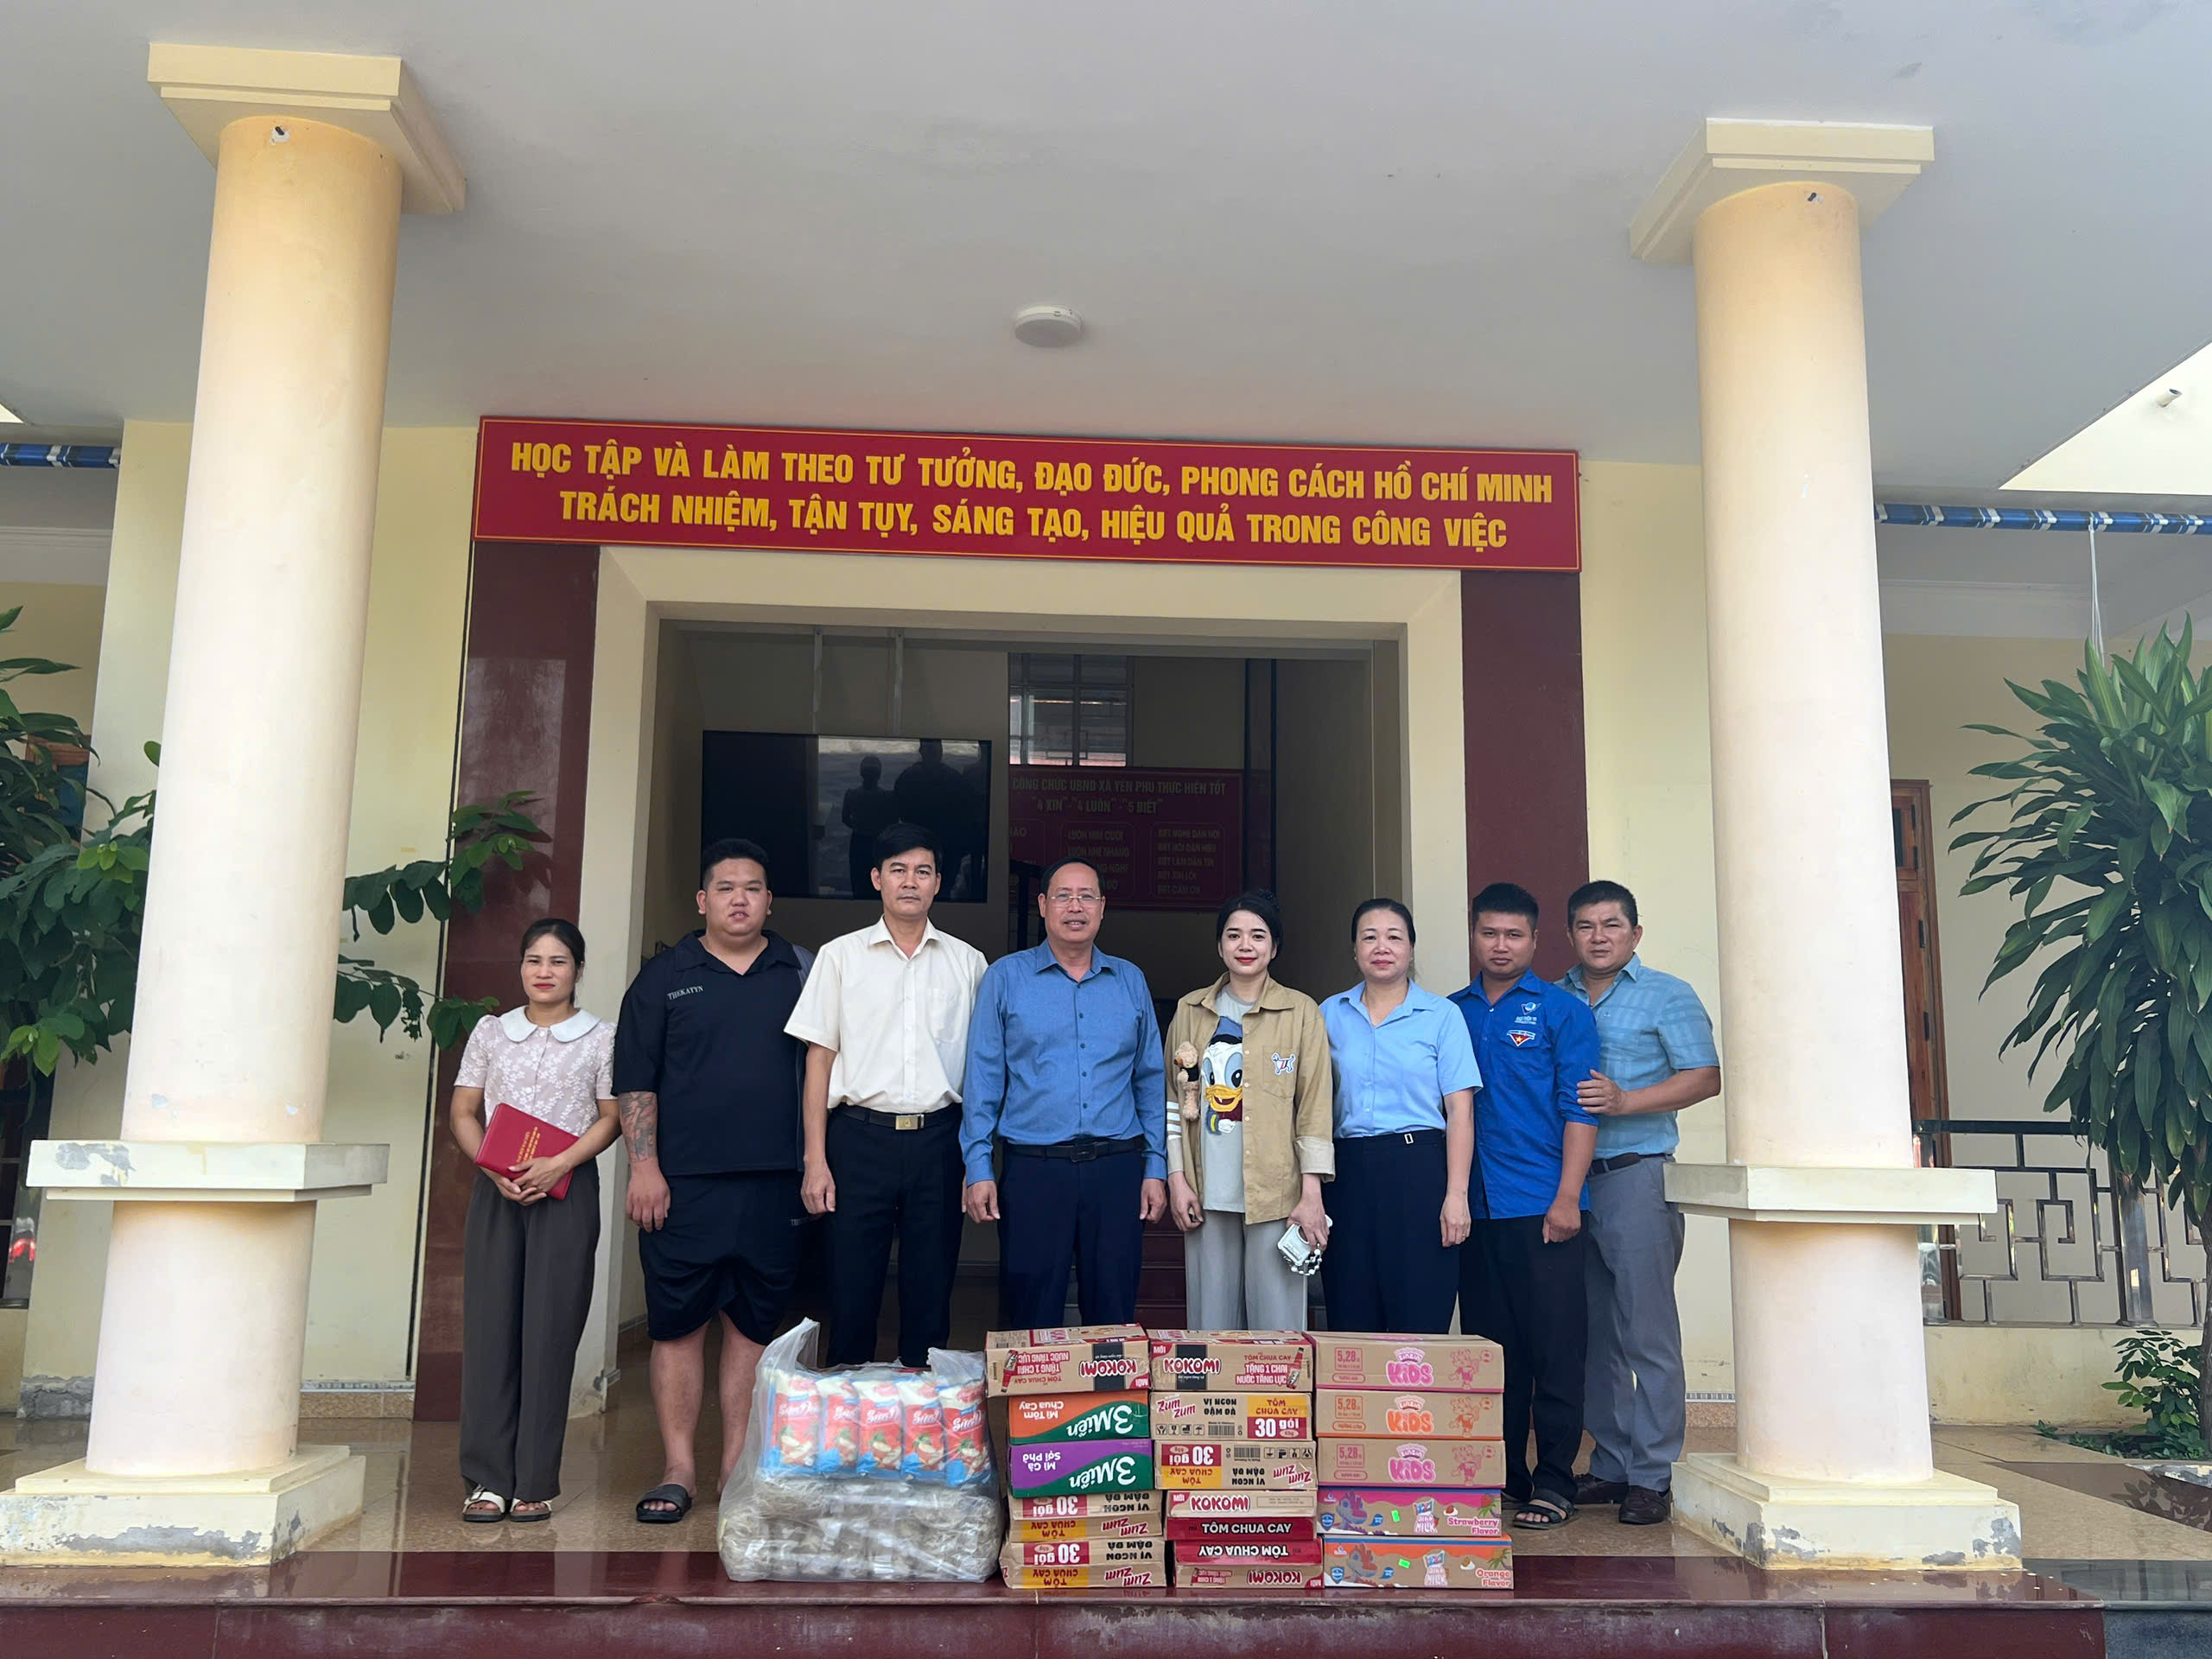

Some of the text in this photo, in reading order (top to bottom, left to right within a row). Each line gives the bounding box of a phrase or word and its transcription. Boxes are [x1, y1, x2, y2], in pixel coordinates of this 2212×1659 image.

[512, 438, 1553, 504] HỌC TẬP VÀ LÀM THEO TƯ TƯỞNG, ĐẠO ĐỨC, PHONG CÁCH HỒ CHÍ MINH
[560, 486, 1507, 553] TRÁCH NHIỆM, TẬN TỤY, SÁNG TẠO, HIỆU QUẢ TRONG CÔNG VIỆC
[1070, 779, 1096, 793] UBND
[1080, 1359, 1137, 1377] KOKOMI
[1163, 1357, 1221, 1375] KOKOMI
[1270, 1364, 1287, 1373] CHAI
[1019, 1401, 1064, 1410] Chua Cay
[1267, 1397, 1286, 1406] TÔM
[1023, 1410, 1058, 1421] Mì Tôm
[1204, 1407, 1236, 1417] ĐẬM ĐÀ
[1255, 1418, 1299, 1438] 30 gói
[1022, 1450, 1061, 1464] Sợi Phở
[1169, 1446, 1214, 1465] 30 gói
[1044, 1461, 1057, 1471] Mì
[1232, 1467, 1265, 1476] ĐẬM ĐÀ
[1182, 1477, 1201, 1485] TÔM
[1105, 1493, 1150, 1503] ĐẬM ĐÀ
[1190, 1495, 1250, 1512] KOKOMI
[1033, 1496, 1078, 1517] 30 gói
[1052, 1521, 1077, 1529] CHUA
[1448, 1516, 1499, 1528] Strawberry
[1042, 1529, 1065, 1538] TÔM
[1202, 1522, 1230, 1534] TÔM
[1231, 1524, 1266, 1534] CHUA
[1267, 1523, 1292, 1534] CAY
[1127, 1541, 1153, 1550] ĐẬM
[1033, 1543, 1080, 1566] 30 gói
[1198, 1546, 1288, 1559] TÔM CHUA CAY
[1033, 1568, 1078, 1577] CHUA CAY
[1248, 1570, 1303, 1584] KOKOMI
[1476, 1570, 1510, 1580] Orange
[1044, 1578, 1067, 1587] TÔM
